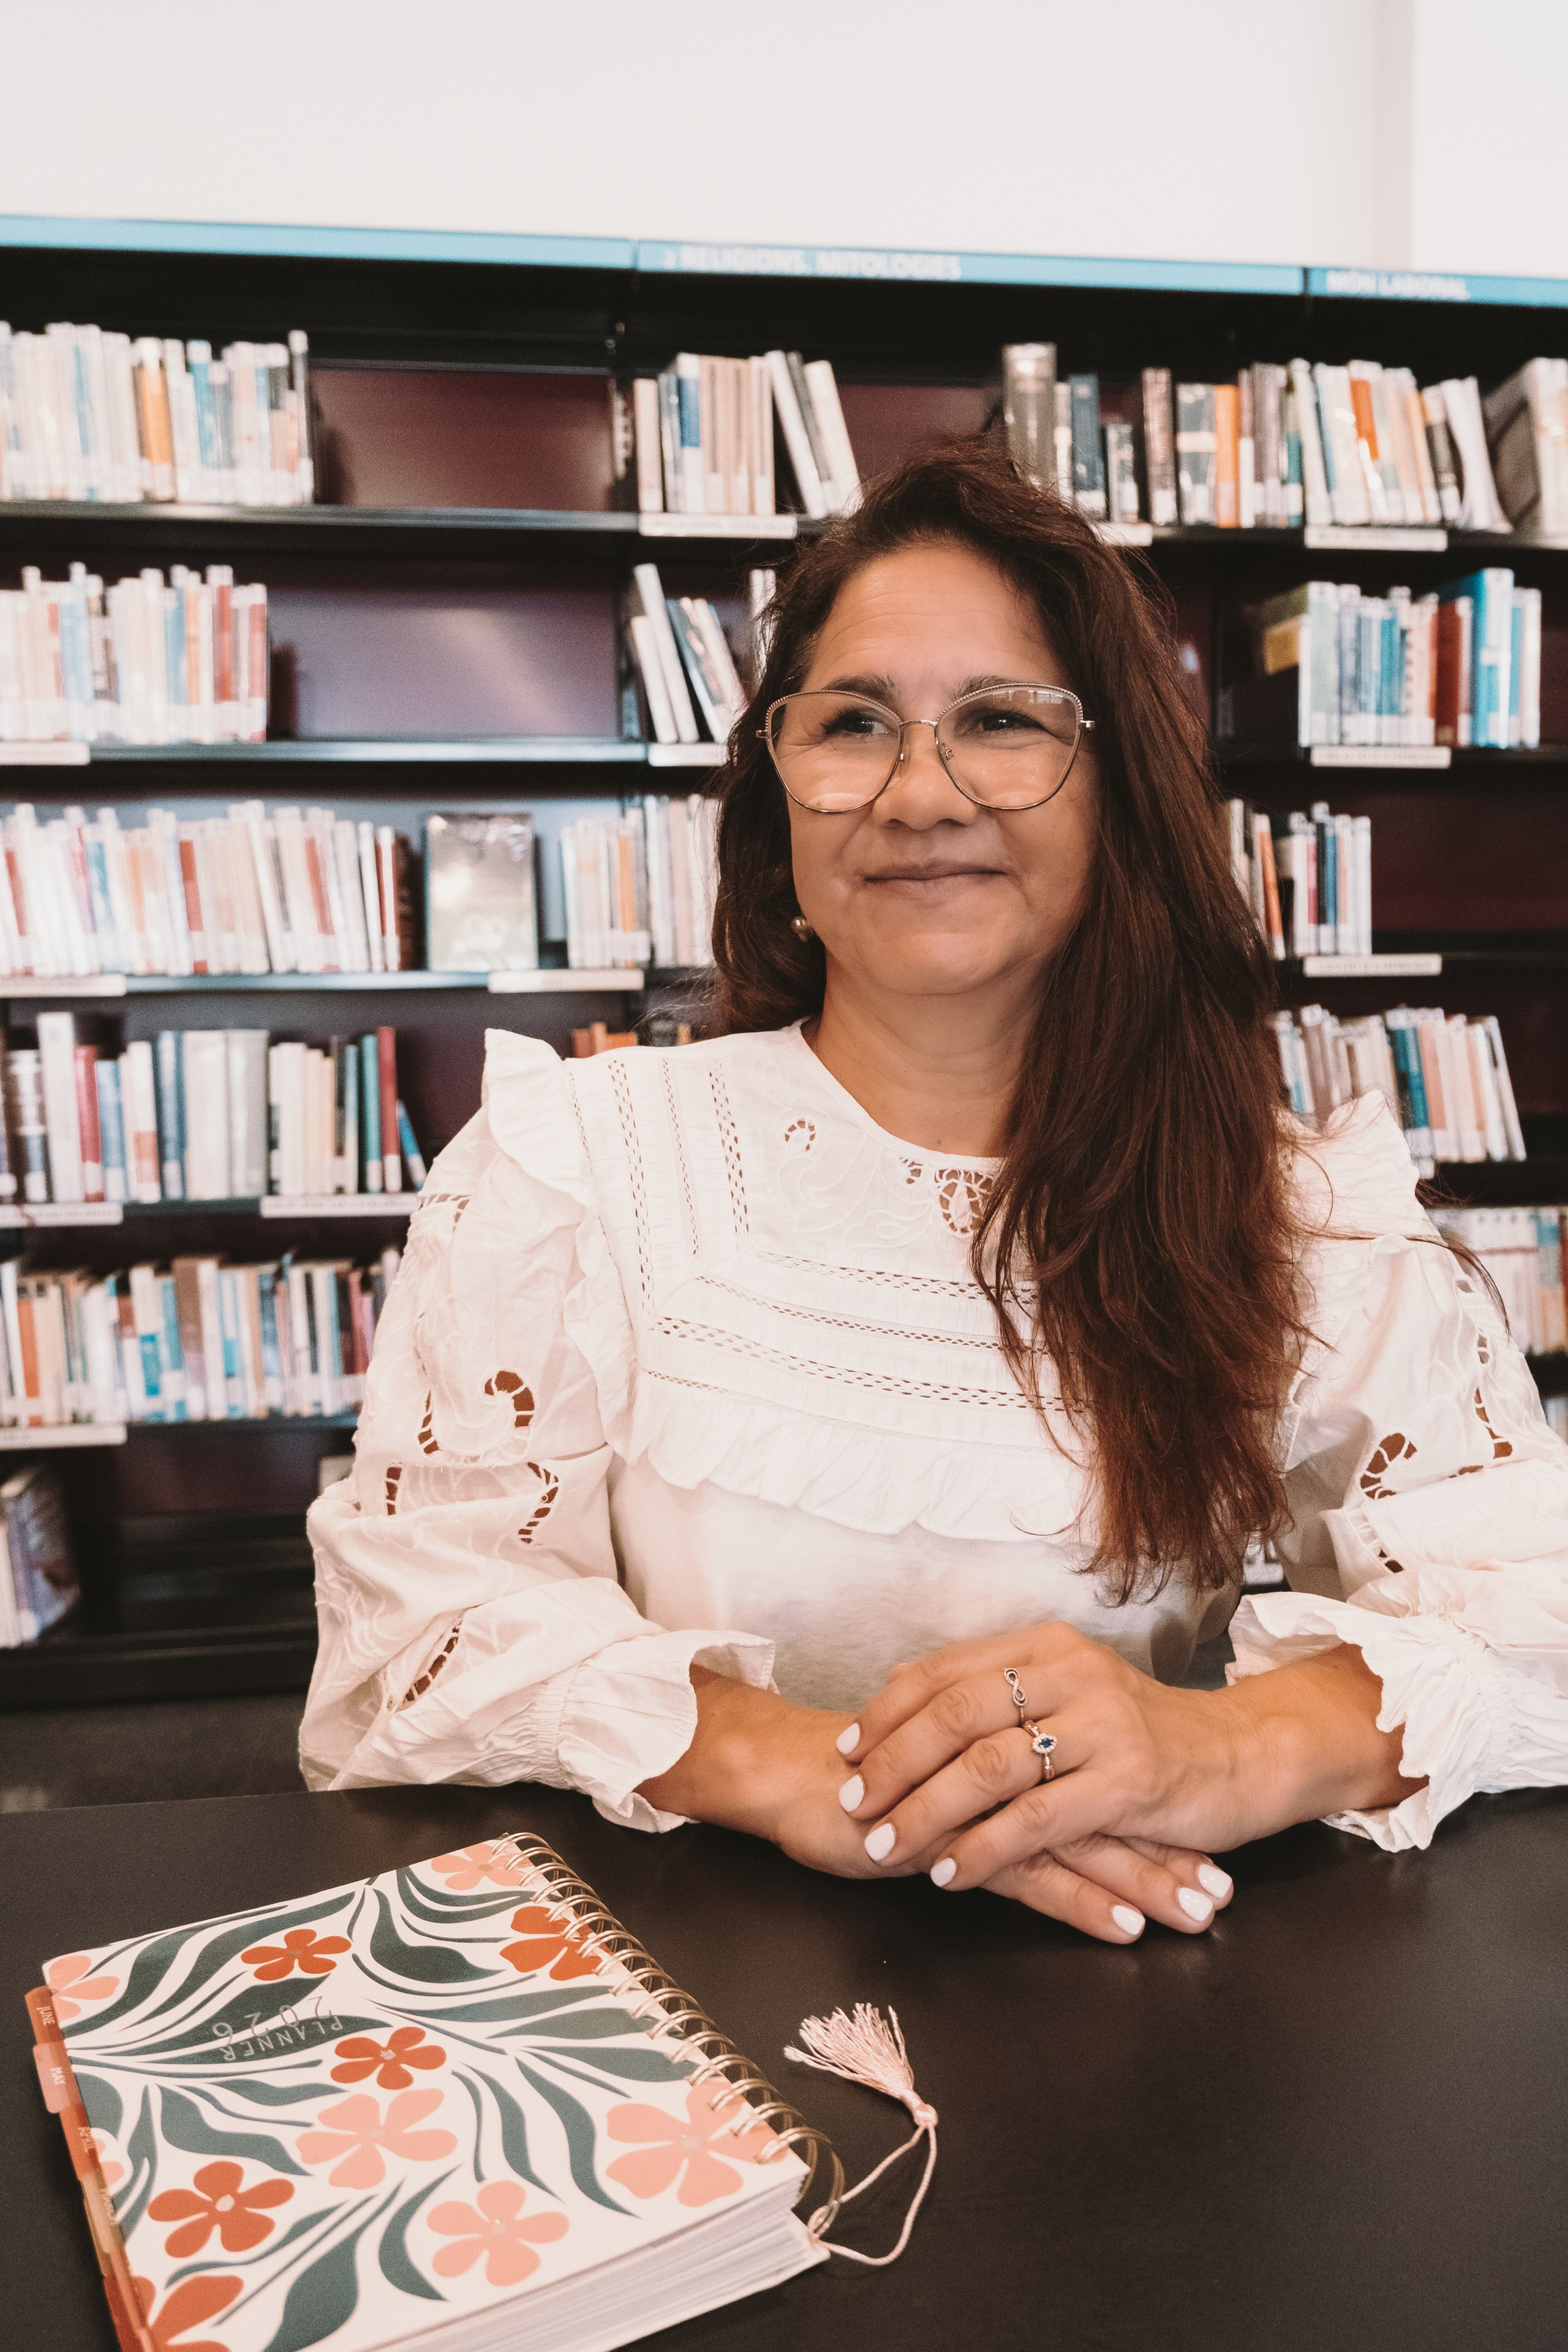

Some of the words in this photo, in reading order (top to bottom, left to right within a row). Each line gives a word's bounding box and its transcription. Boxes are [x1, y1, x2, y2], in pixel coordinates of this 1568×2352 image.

[815, 252, 962, 279] MITOLOGIES
[36, 2005, 55, 2026] JUNE
[213, 1995, 333, 2045] 2026
[219, 2015, 344, 2062] PLANNER
[50, 2067, 67, 2086] MAY
[78, 2127, 96, 2154] APRIL
